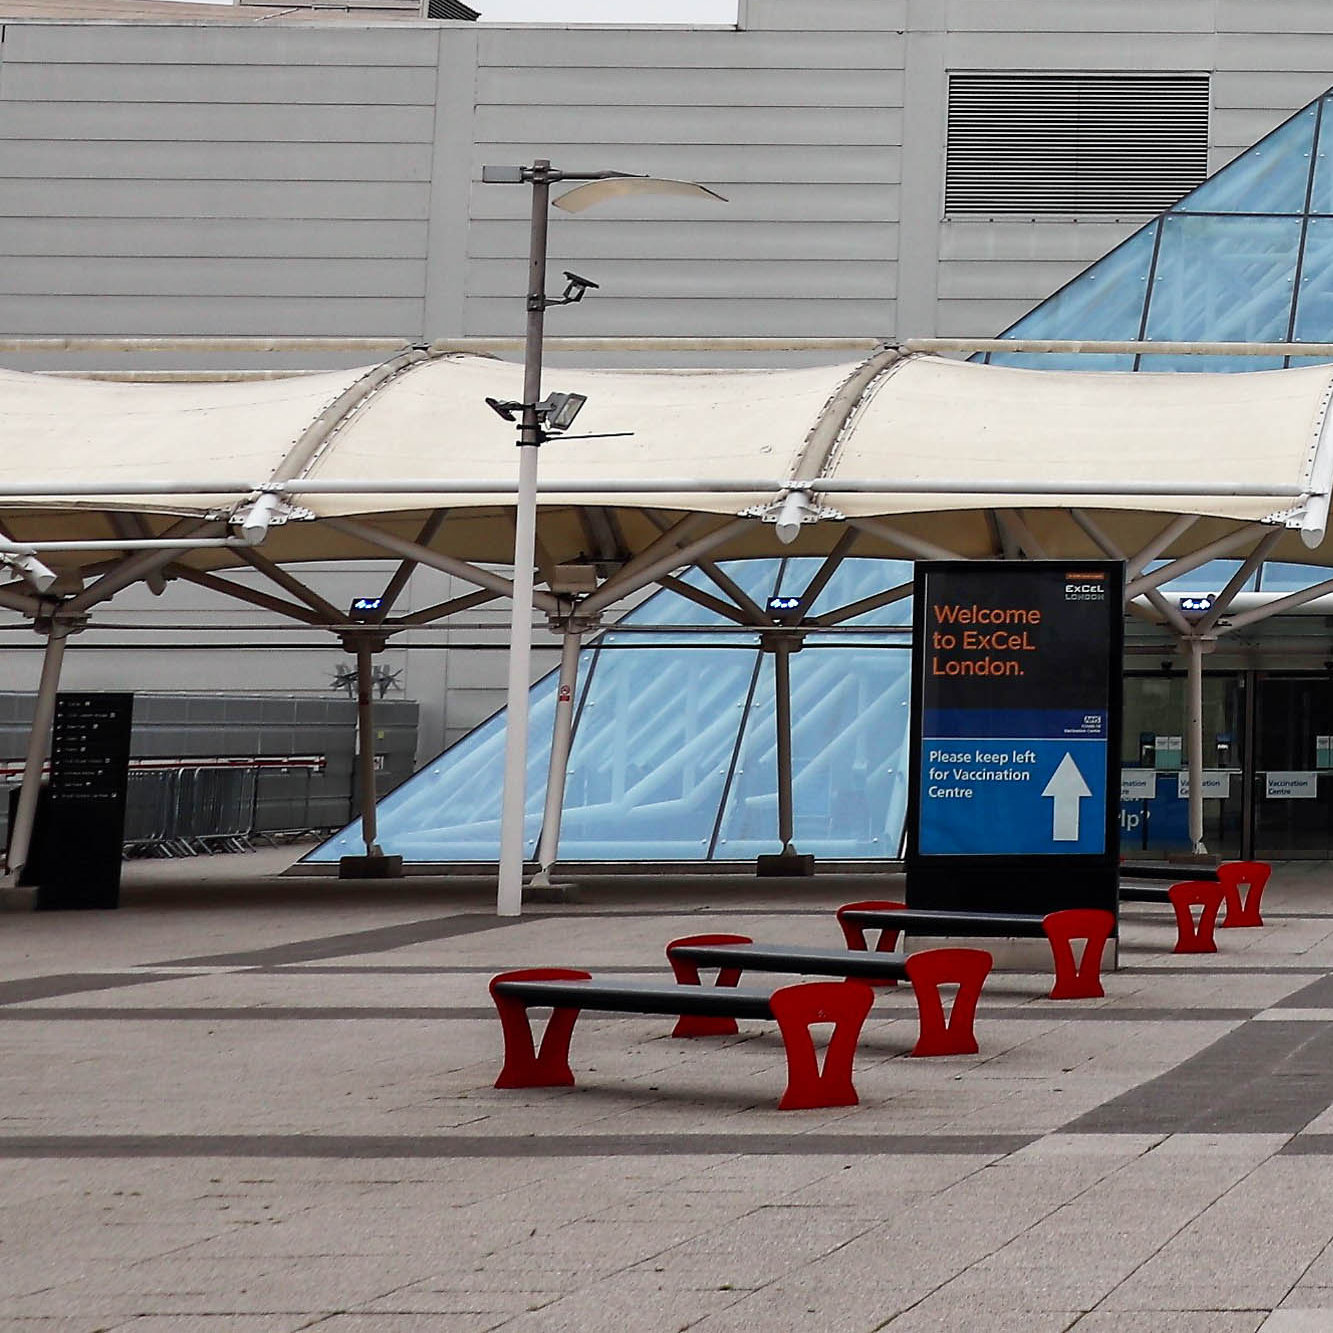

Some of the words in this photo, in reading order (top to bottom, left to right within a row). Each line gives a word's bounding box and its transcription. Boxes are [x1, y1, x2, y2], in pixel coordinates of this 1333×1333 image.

[934, 605, 1041, 624] Welcome
[933, 631, 956, 649] to
[963, 630, 1036, 650] ExCeL
[933, 657, 1025, 675] London.
[929, 750, 971, 763] Please
[975, 750, 1009, 766] keep
[1012, 750, 1036, 763] left
[929, 767, 950, 781] for
[953, 768, 1030, 781] Vaccination
[1268, 779, 1308, 787] Vaccination
[928, 786, 973, 798] Centre
